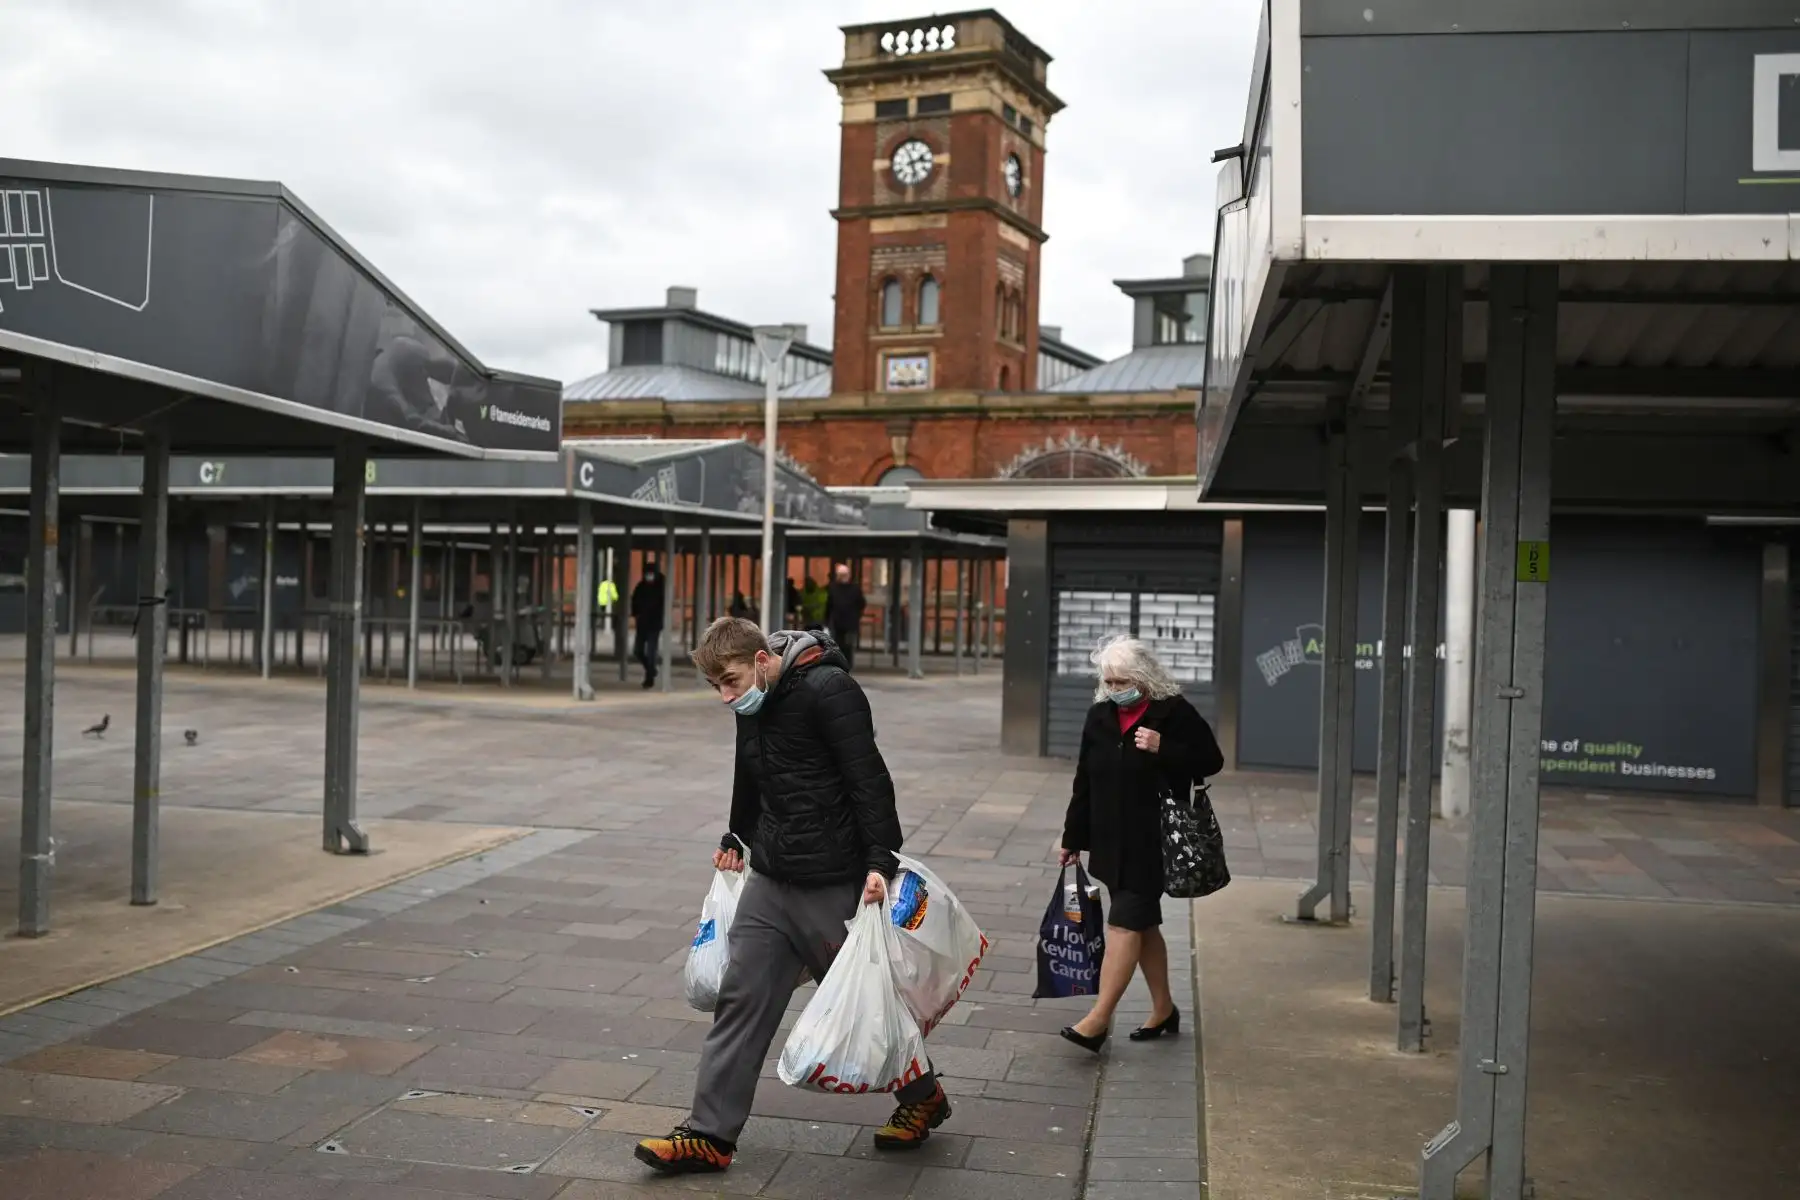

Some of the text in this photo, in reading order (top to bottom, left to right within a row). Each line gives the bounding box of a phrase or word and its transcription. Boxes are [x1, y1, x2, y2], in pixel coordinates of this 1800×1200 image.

[200, 462, 225, 483] C7
[364, 461, 376, 482] 8
[580, 462, 594, 487] C
[1561, 738, 1579, 753] of
[1583, 741, 1643, 759] quality
[1621, 760, 1716, 780] businesses
